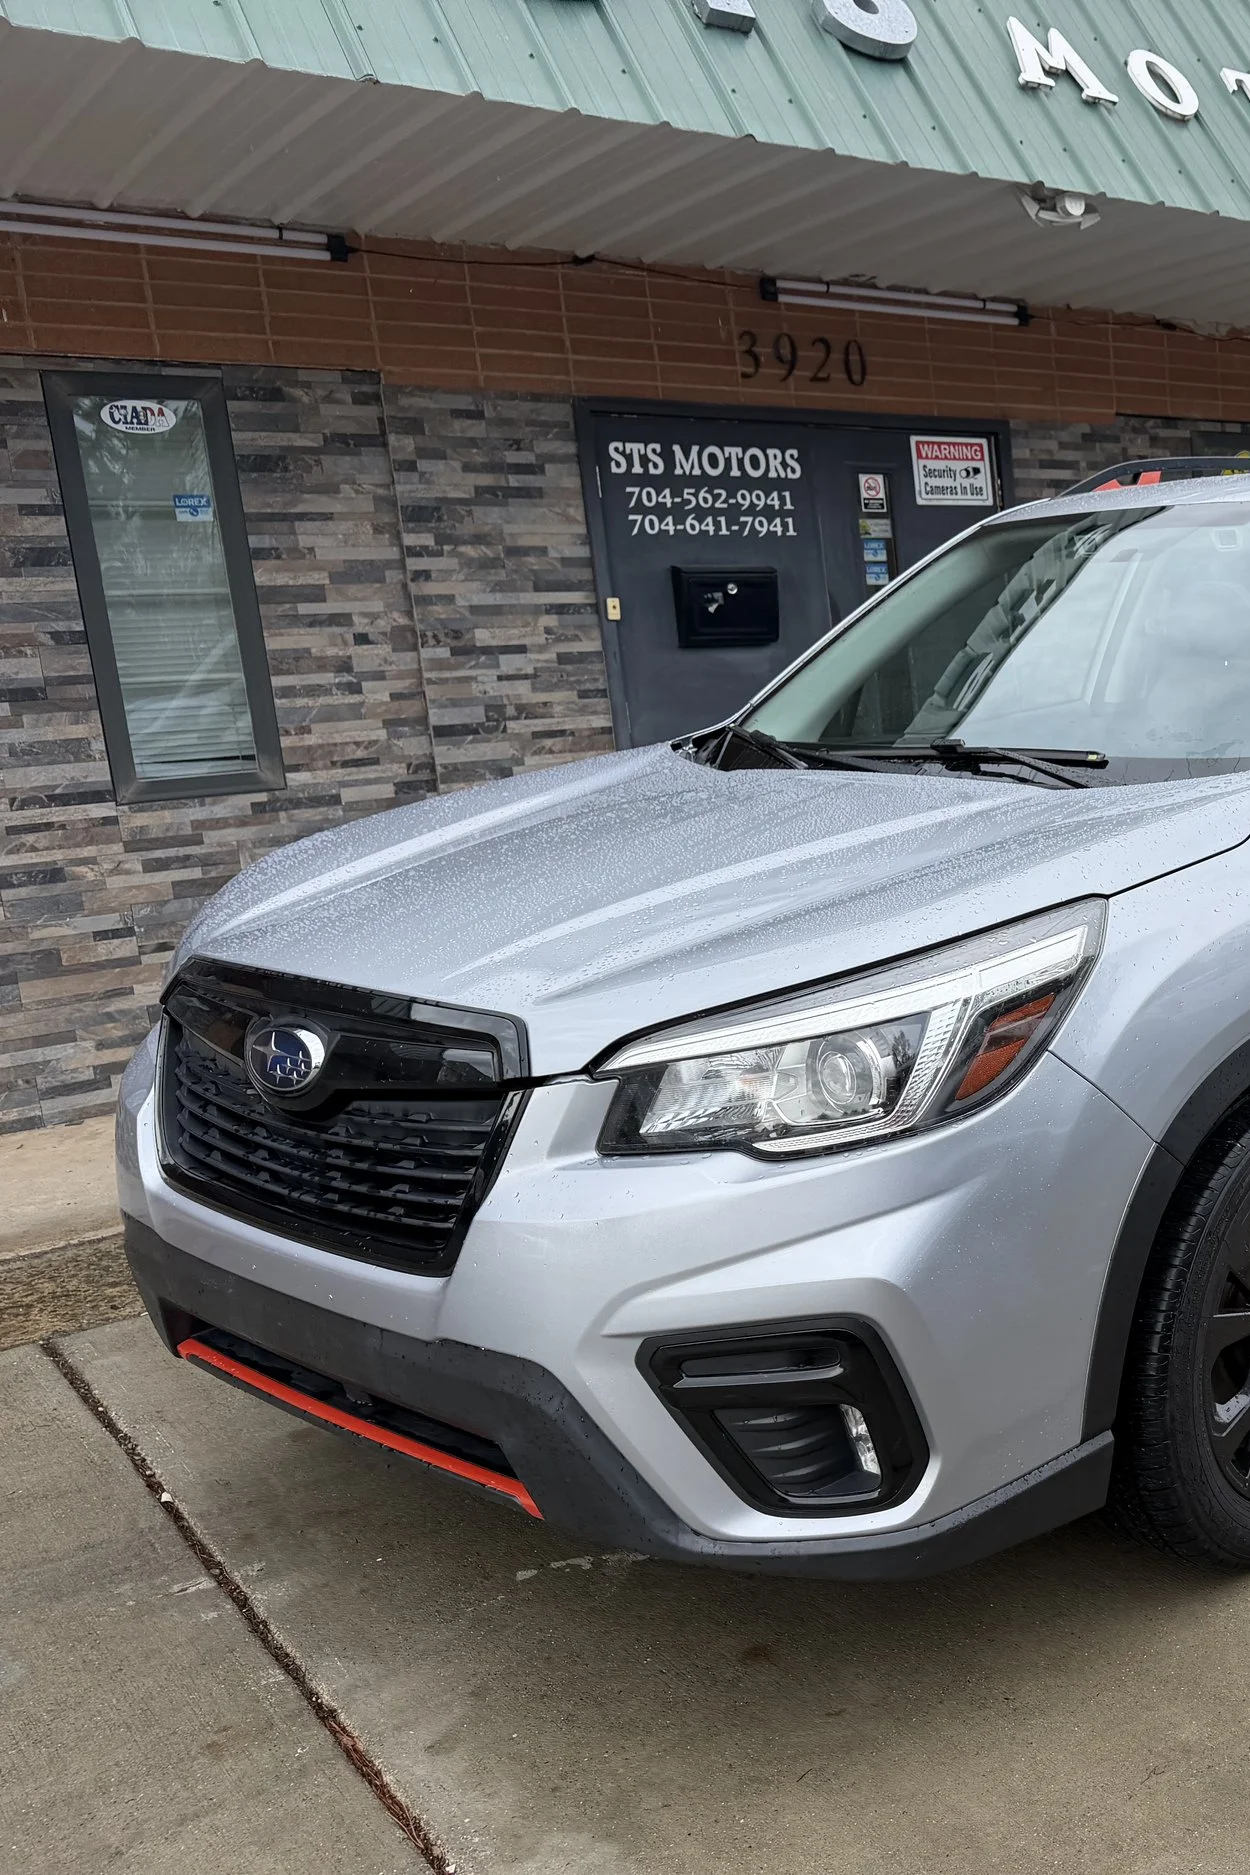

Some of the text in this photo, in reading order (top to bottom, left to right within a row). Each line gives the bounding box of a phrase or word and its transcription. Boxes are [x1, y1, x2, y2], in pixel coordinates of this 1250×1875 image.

[738, 330, 868, 386] 3920
[608, 441, 801, 480] STS MOTORS
[919, 443, 982, 459] WARNING
[922, 464, 958, 482] Security
[625, 486, 795, 511] 704-562-9941
[924, 481, 984, 497] Cameras In Use
[175, 497, 208, 506] LOREX
[628, 513, 797, 538] 704-641-7941
